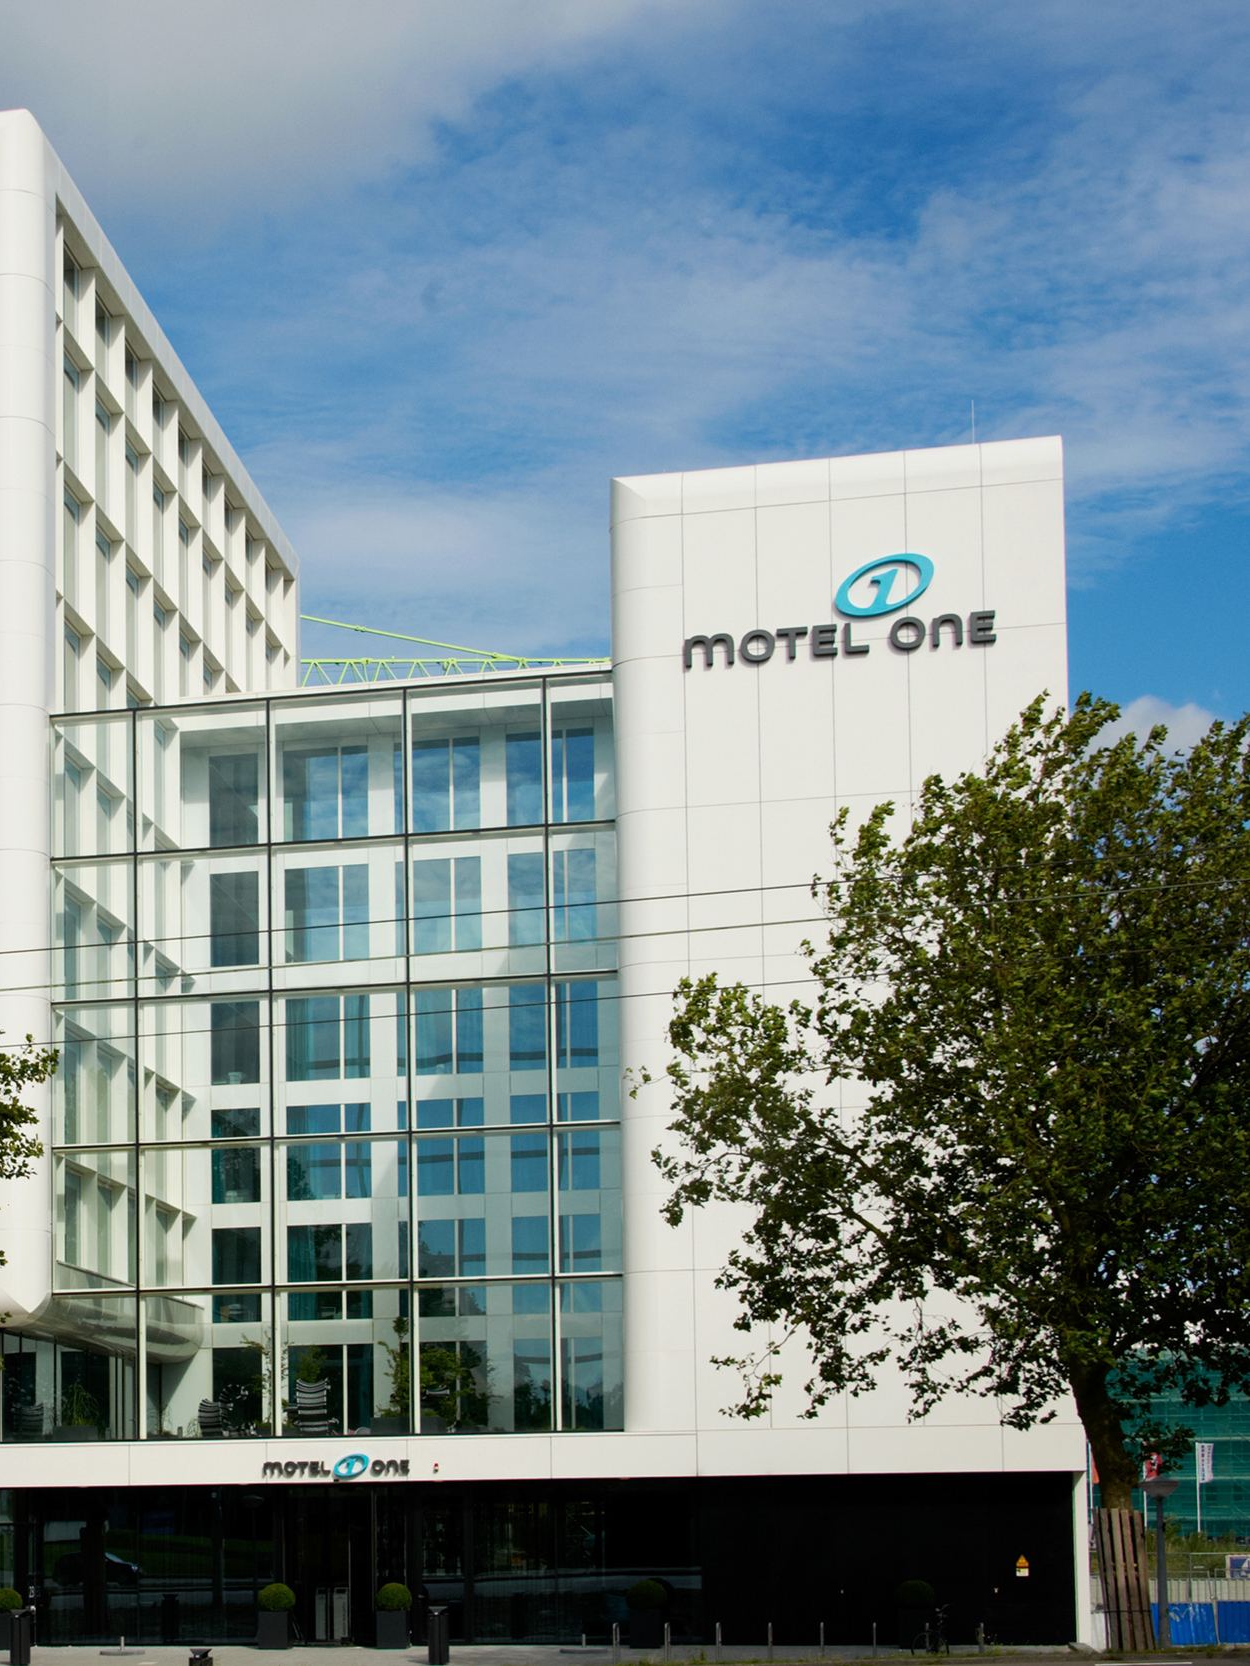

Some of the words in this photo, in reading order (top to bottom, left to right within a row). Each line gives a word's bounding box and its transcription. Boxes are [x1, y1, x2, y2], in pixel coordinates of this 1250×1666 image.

[684, 622, 870, 669] MOTEL
[889, 609, 997, 652] ONE
[262, 1460, 331, 1478] MOTEL
[370, 1459, 411, 1477] ONE
